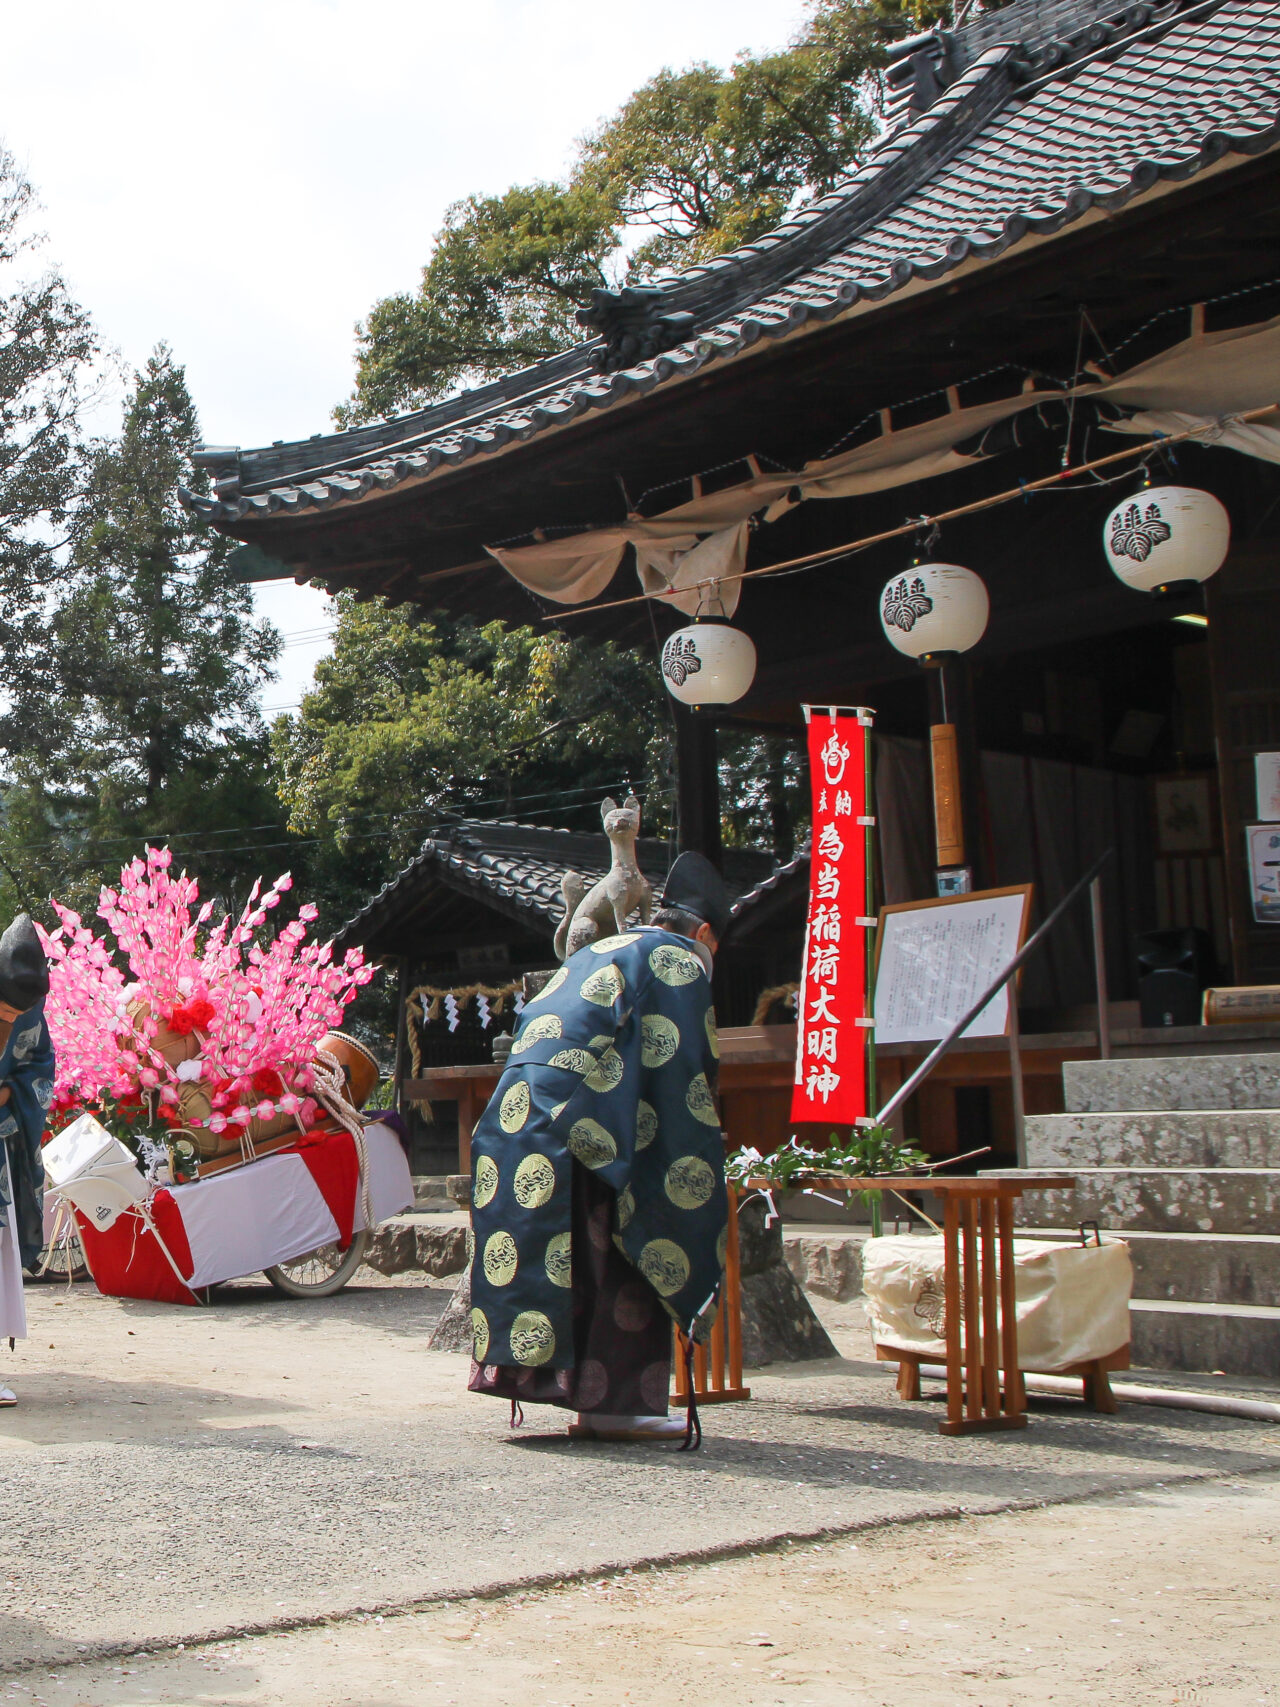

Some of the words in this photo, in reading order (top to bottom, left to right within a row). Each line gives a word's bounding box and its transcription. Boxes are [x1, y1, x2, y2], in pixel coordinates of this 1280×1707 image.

[805, 821, 845, 1105] 為当稲荷大明神
